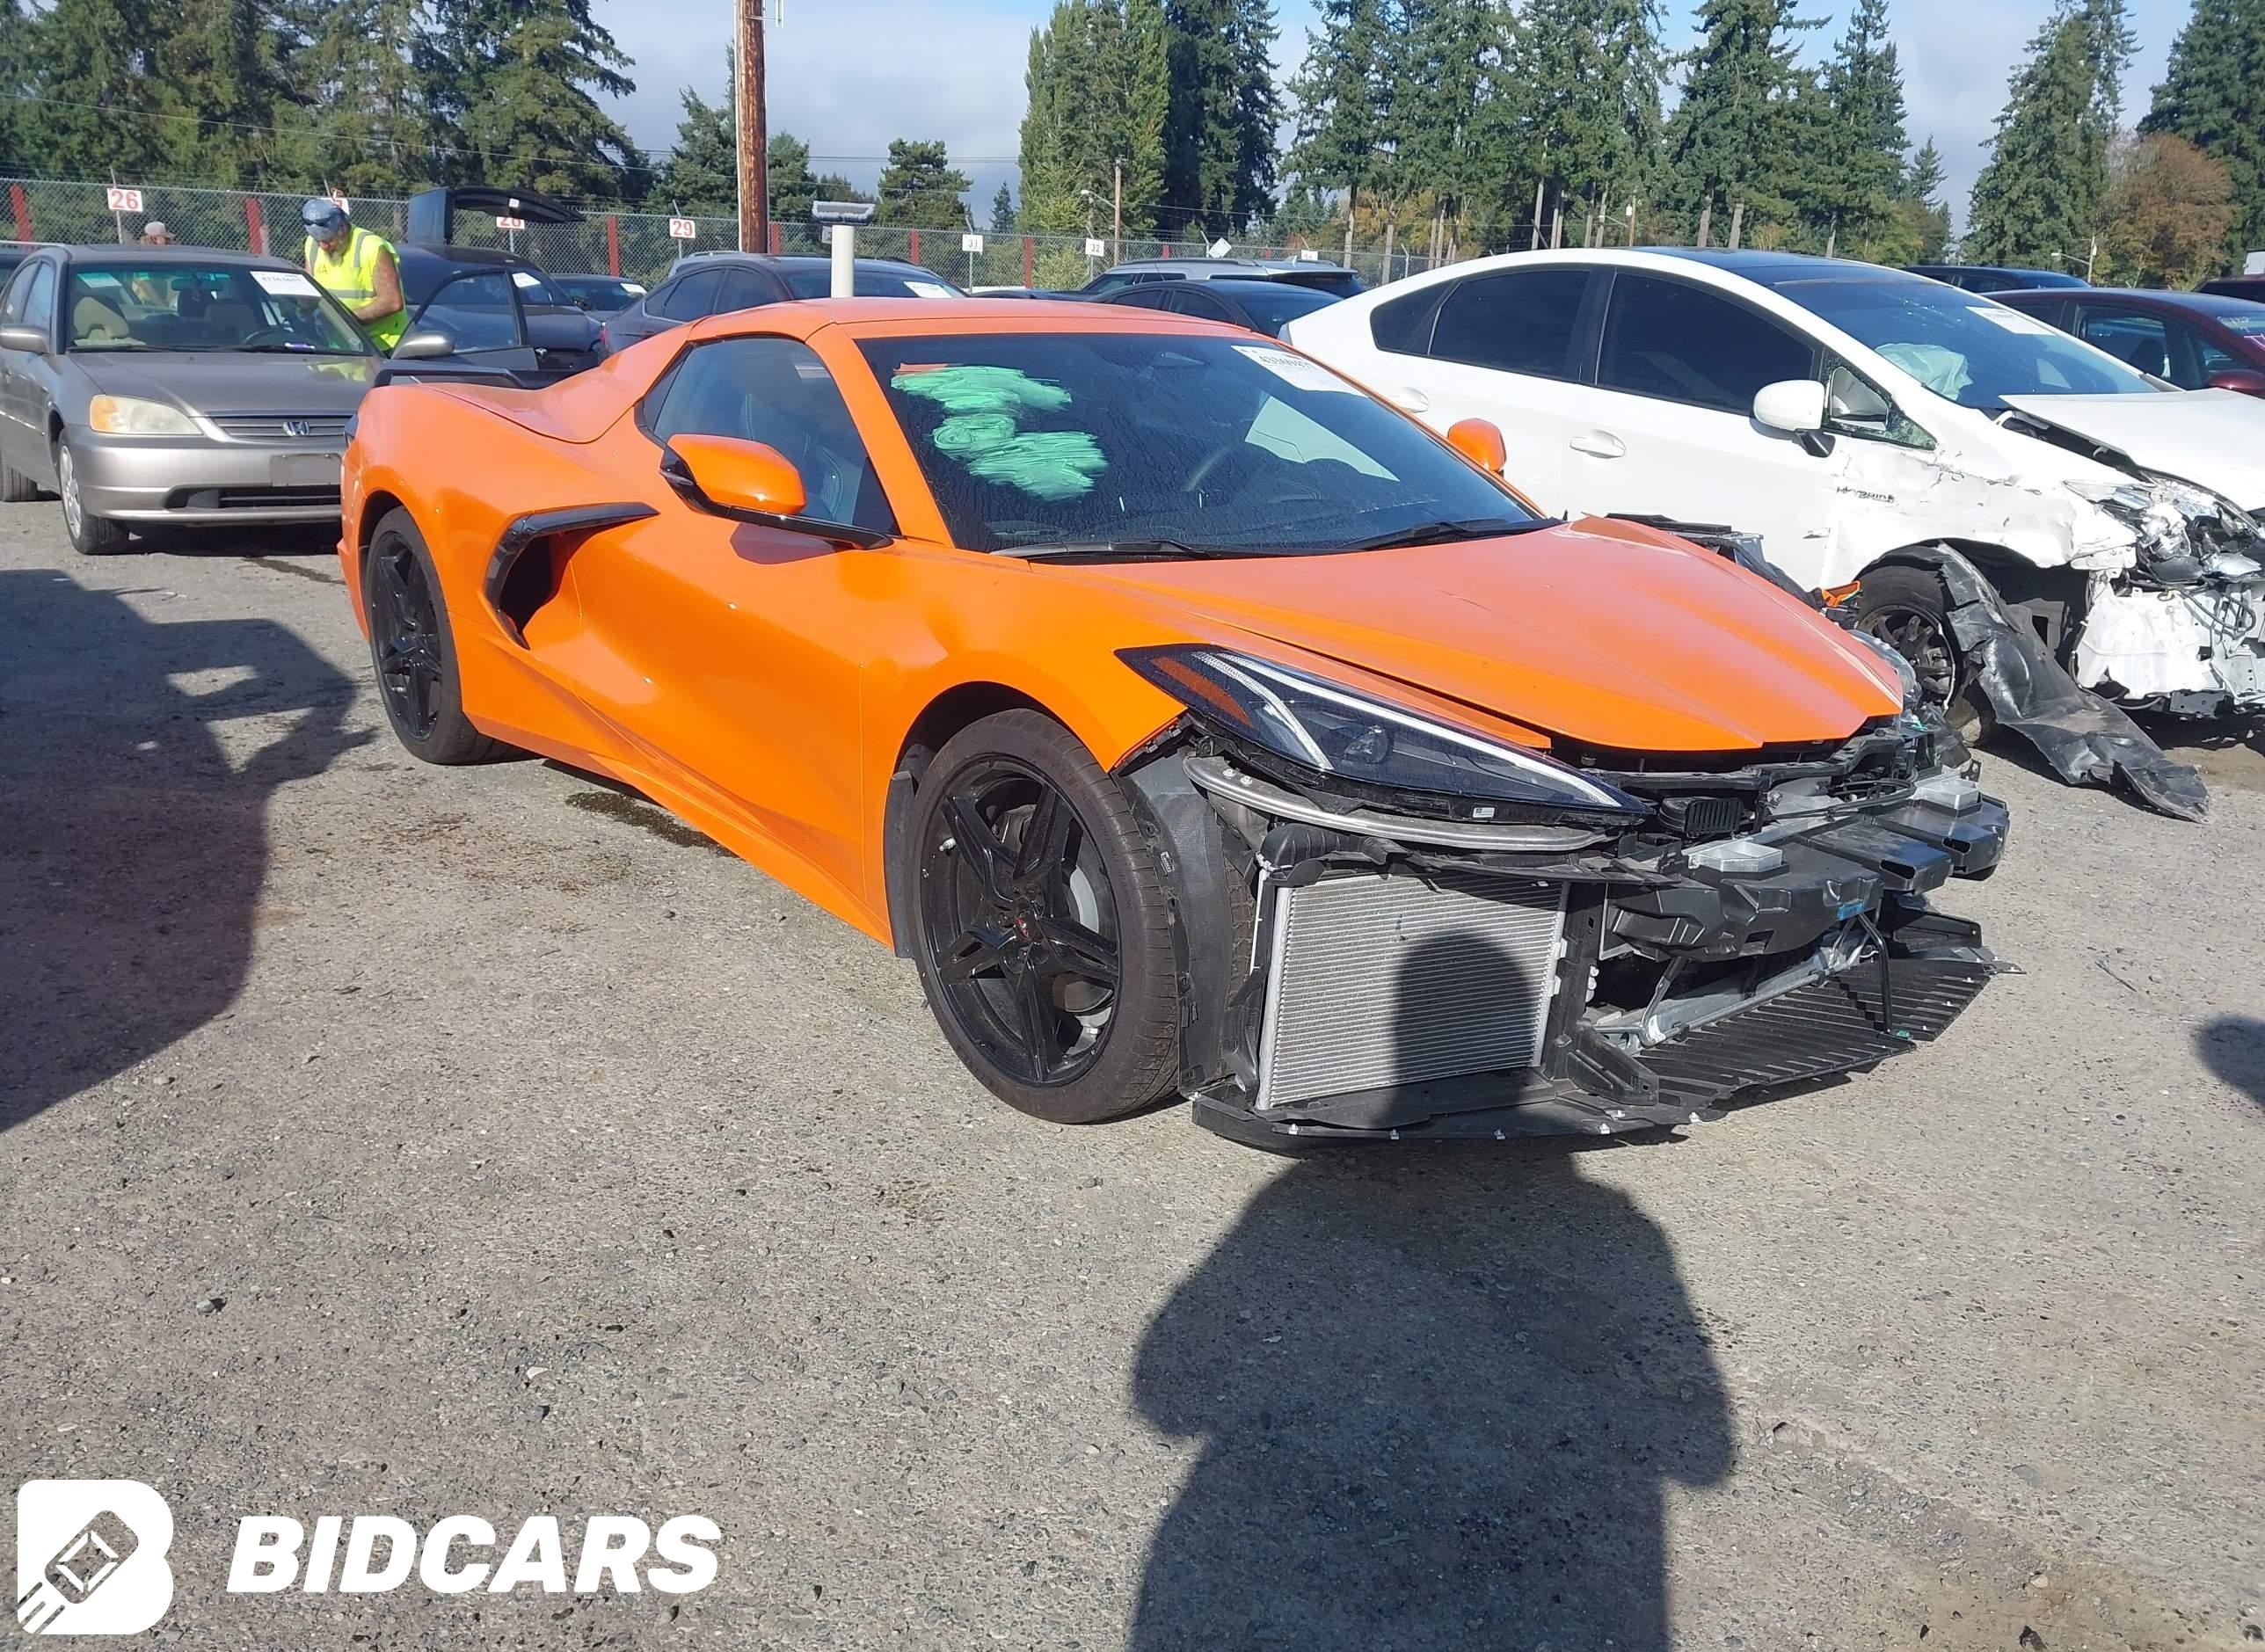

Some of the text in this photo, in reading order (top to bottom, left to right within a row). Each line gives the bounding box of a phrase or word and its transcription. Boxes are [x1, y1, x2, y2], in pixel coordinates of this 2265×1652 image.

[111, 190, 139, 209] 26
[673, 220, 693, 237] 29
[968, 238, 978, 248] 31
[1090, 243, 1101, 253] 32
